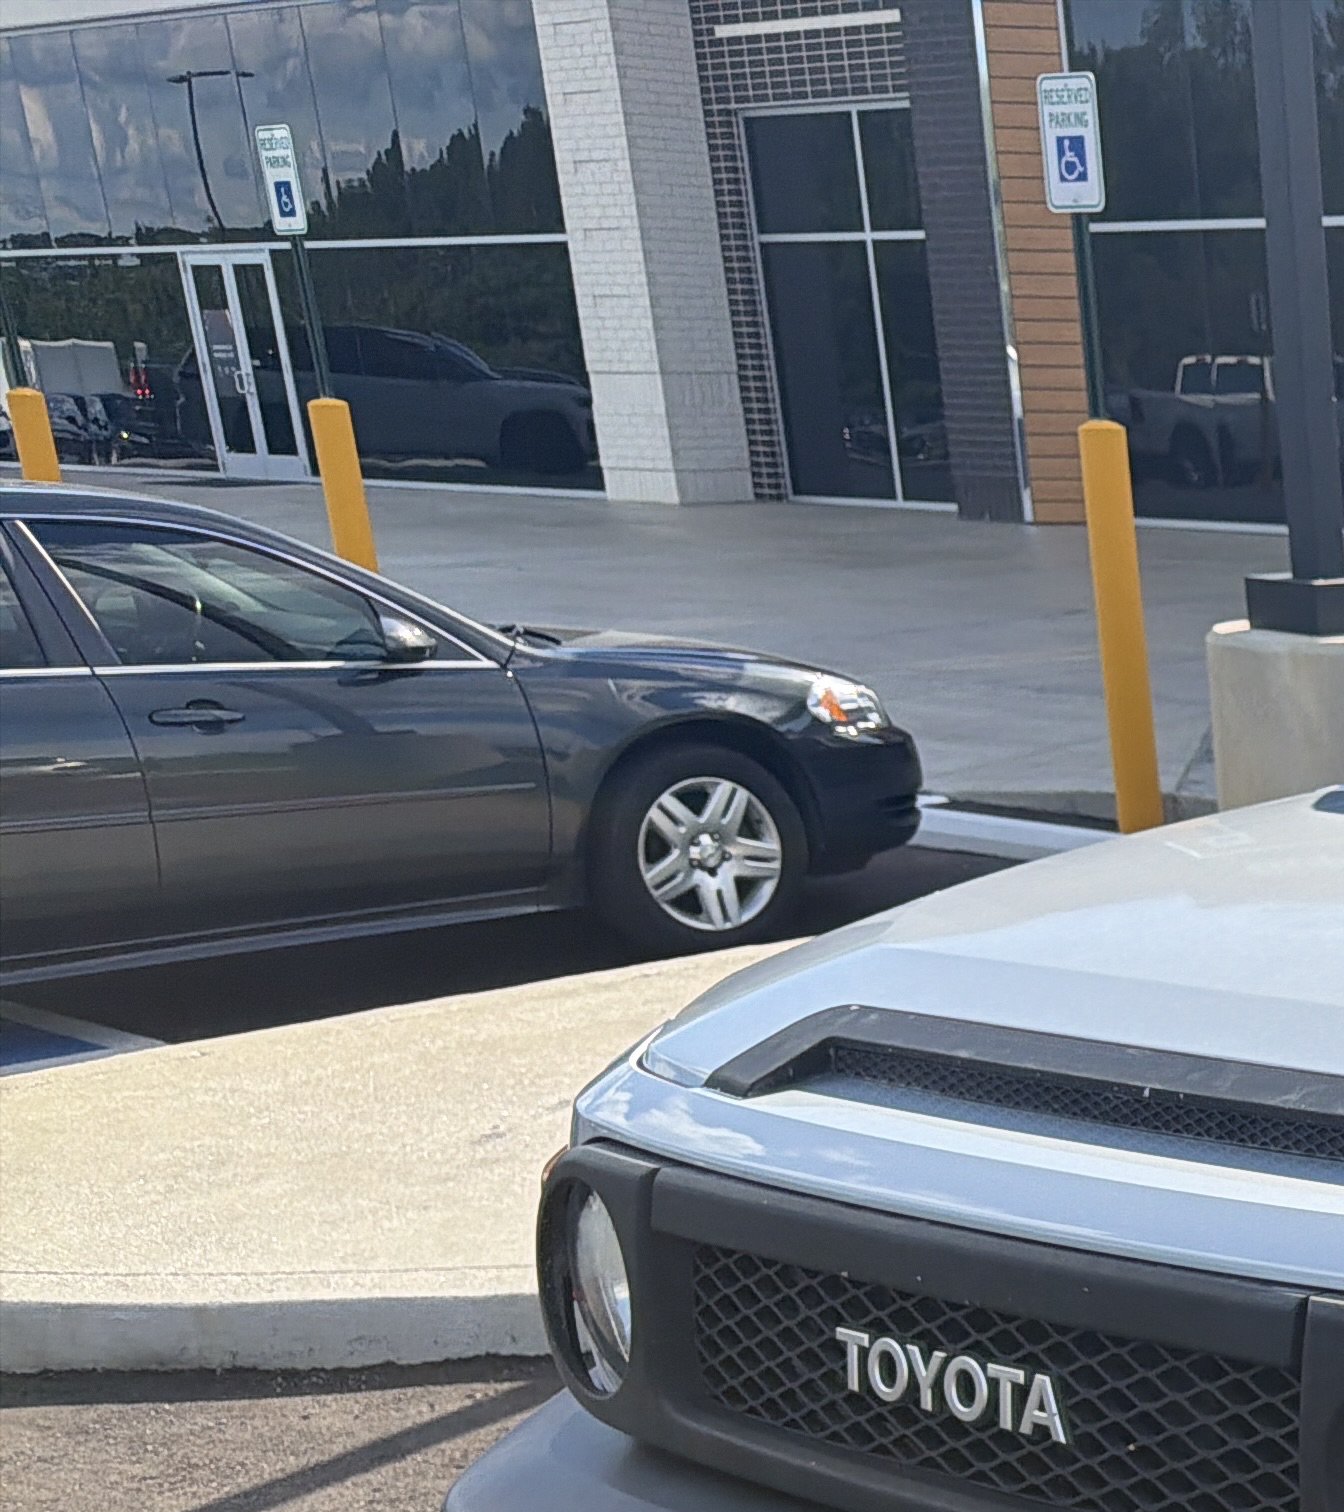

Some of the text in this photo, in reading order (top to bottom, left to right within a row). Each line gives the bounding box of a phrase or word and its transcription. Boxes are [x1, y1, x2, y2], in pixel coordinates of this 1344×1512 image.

[1043, 87, 1090, 105] RESERVED
[1048, 111, 1088, 128] PARKING
[835, 1326, 1067, 1445] TOYOTA
